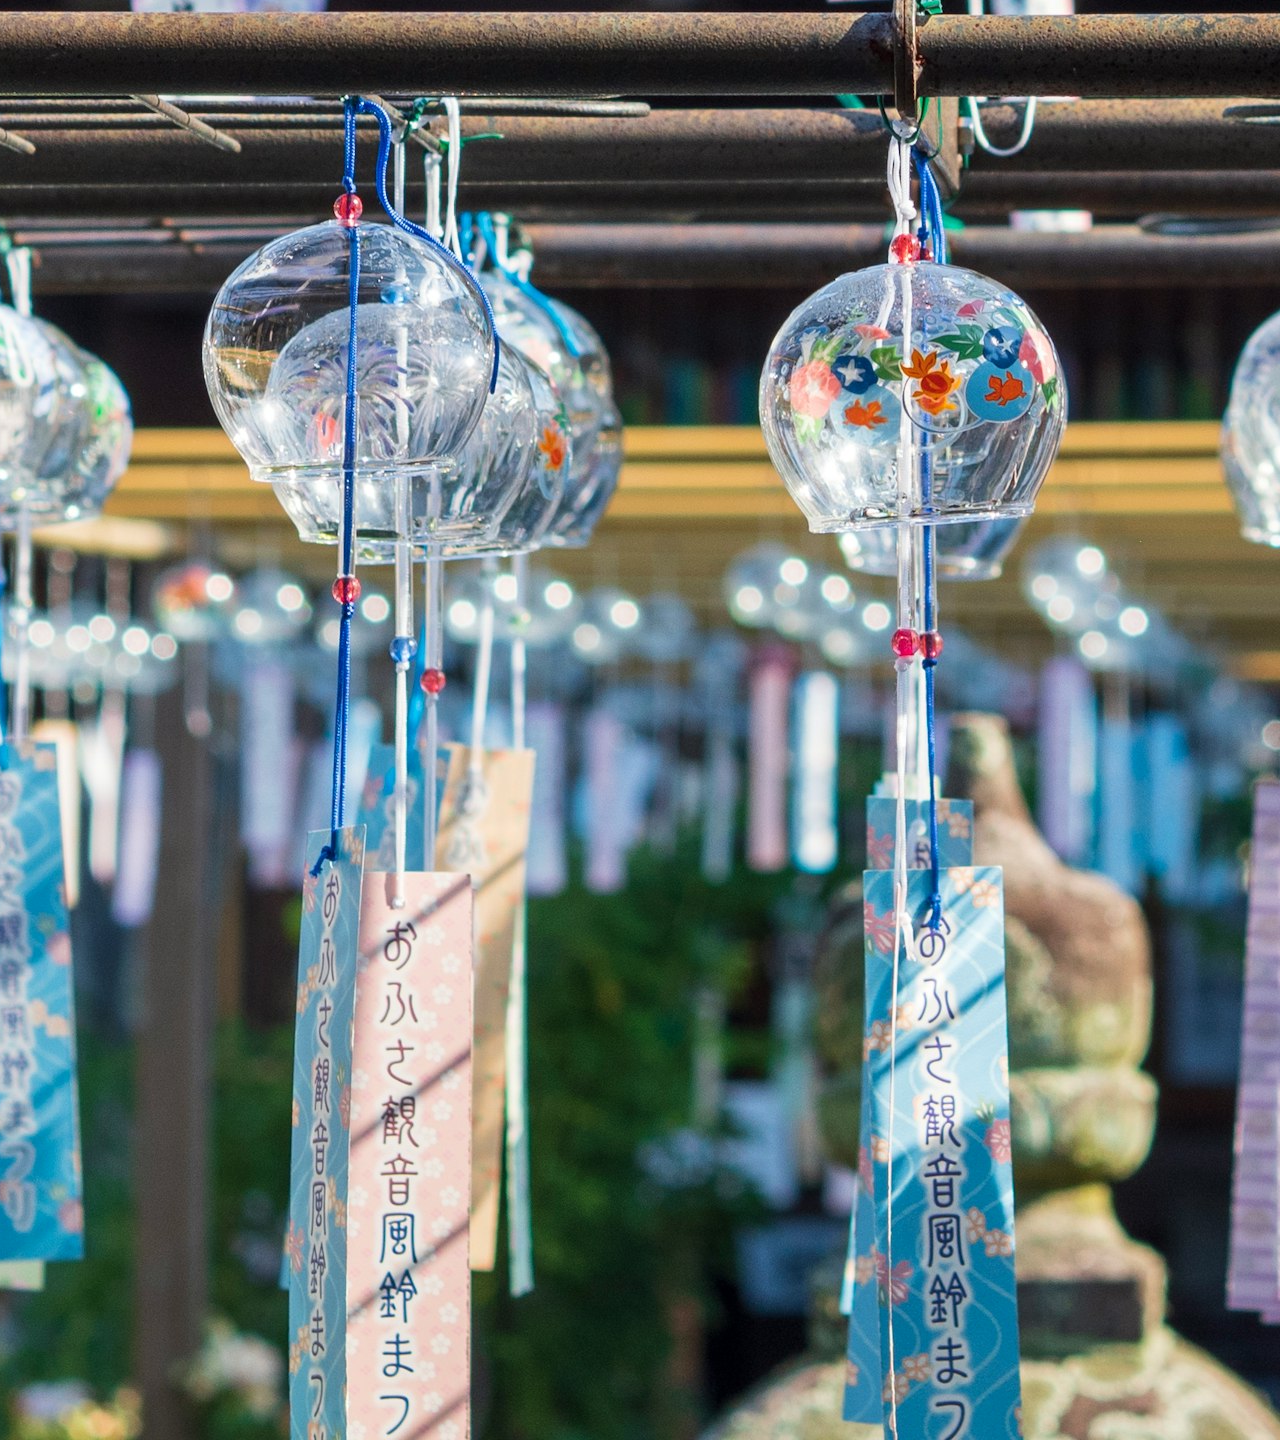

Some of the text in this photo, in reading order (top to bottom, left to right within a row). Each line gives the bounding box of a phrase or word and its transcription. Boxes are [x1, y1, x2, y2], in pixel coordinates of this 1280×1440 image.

[311, 875, 340, 1440] おふさ観音風鈴まつ
[380, 921, 418, 1436] おふさ観音風鈴まつ
